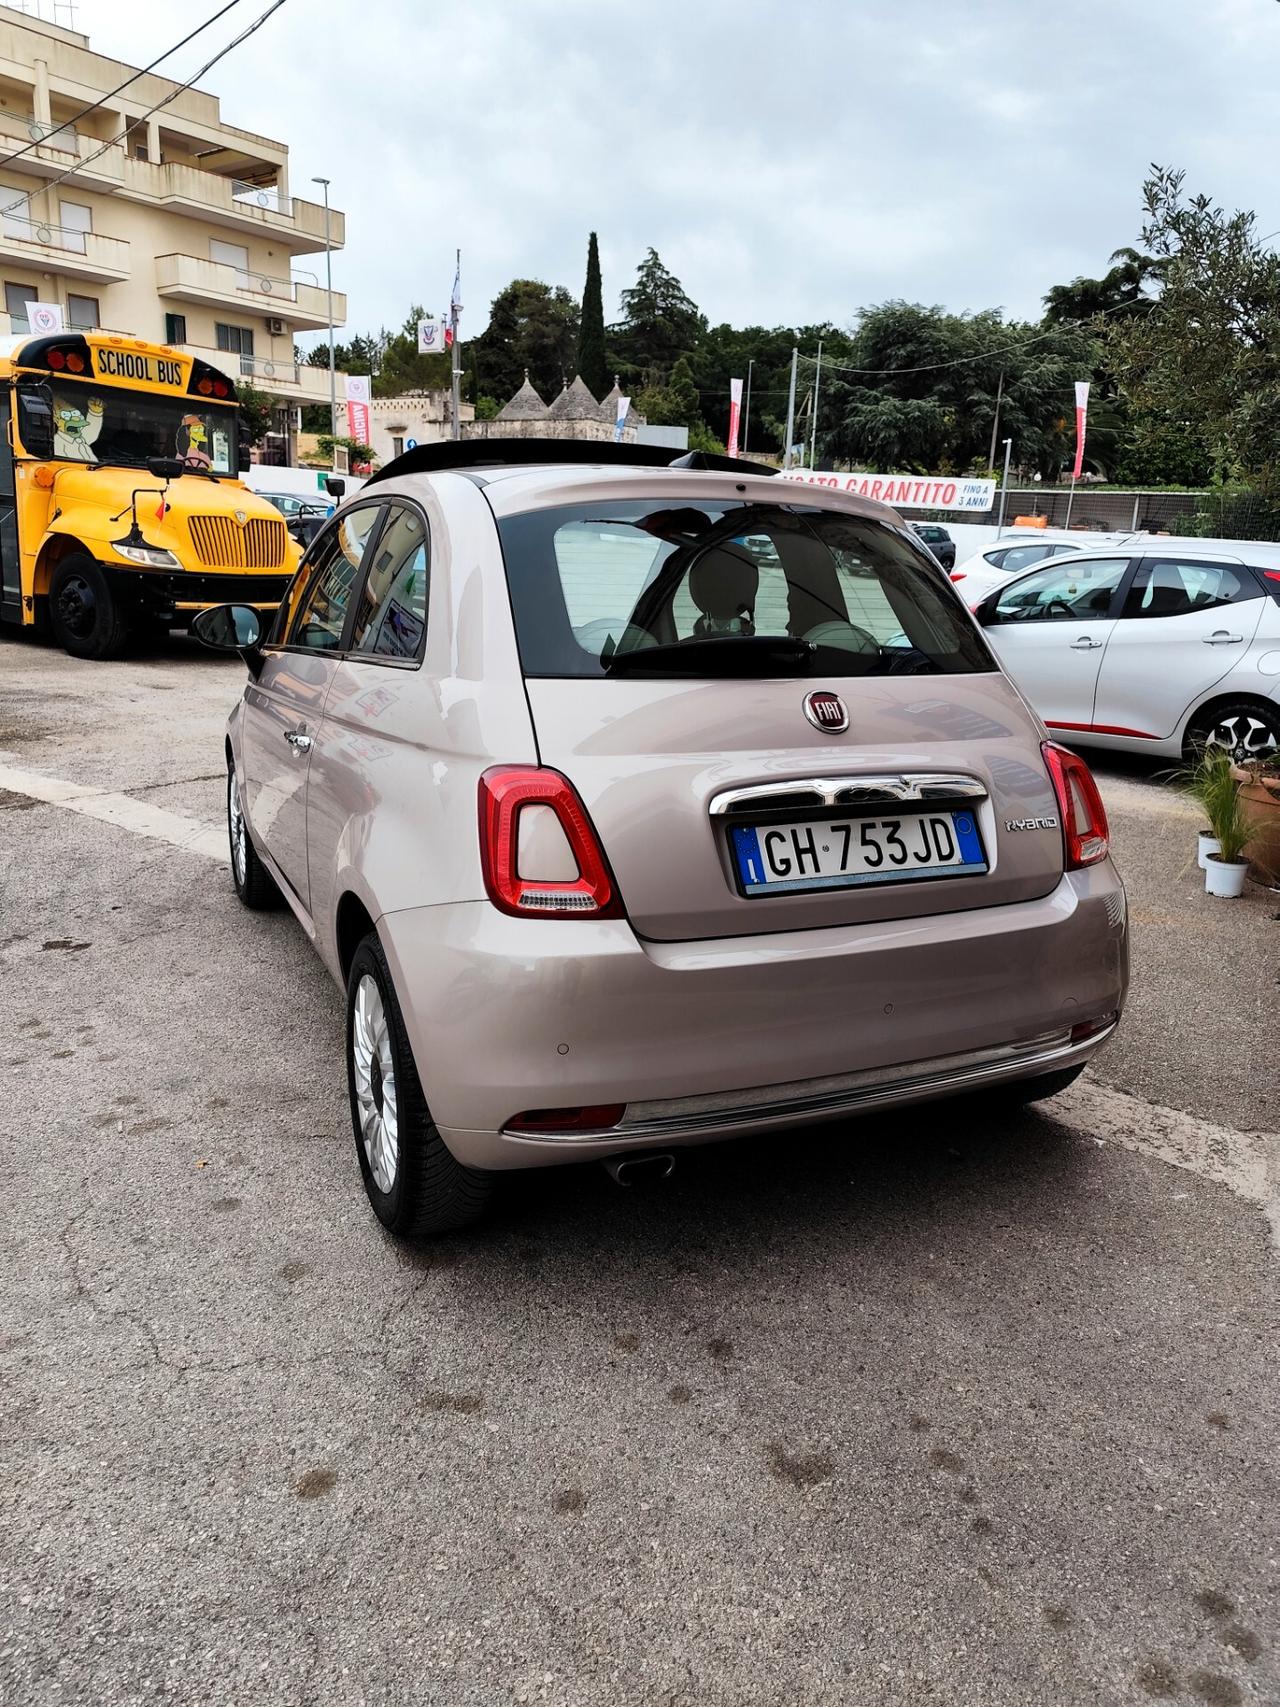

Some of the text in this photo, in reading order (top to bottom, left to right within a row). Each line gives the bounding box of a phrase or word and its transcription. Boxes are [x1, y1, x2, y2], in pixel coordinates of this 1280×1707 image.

[98, 349, 182, 386] SCHOOL BUS
[846, 478, 956, 504] GARANTITO
[963, 484, 989, 494] FINO A
[958, 496, 989, 507] 3 ANNI
[814, 701, 842, 720] FIAT
[1005, 817, 1057, 832] HYBRID
[765, 828, 821, 876] GH
[747, 858, 757, 881] I
